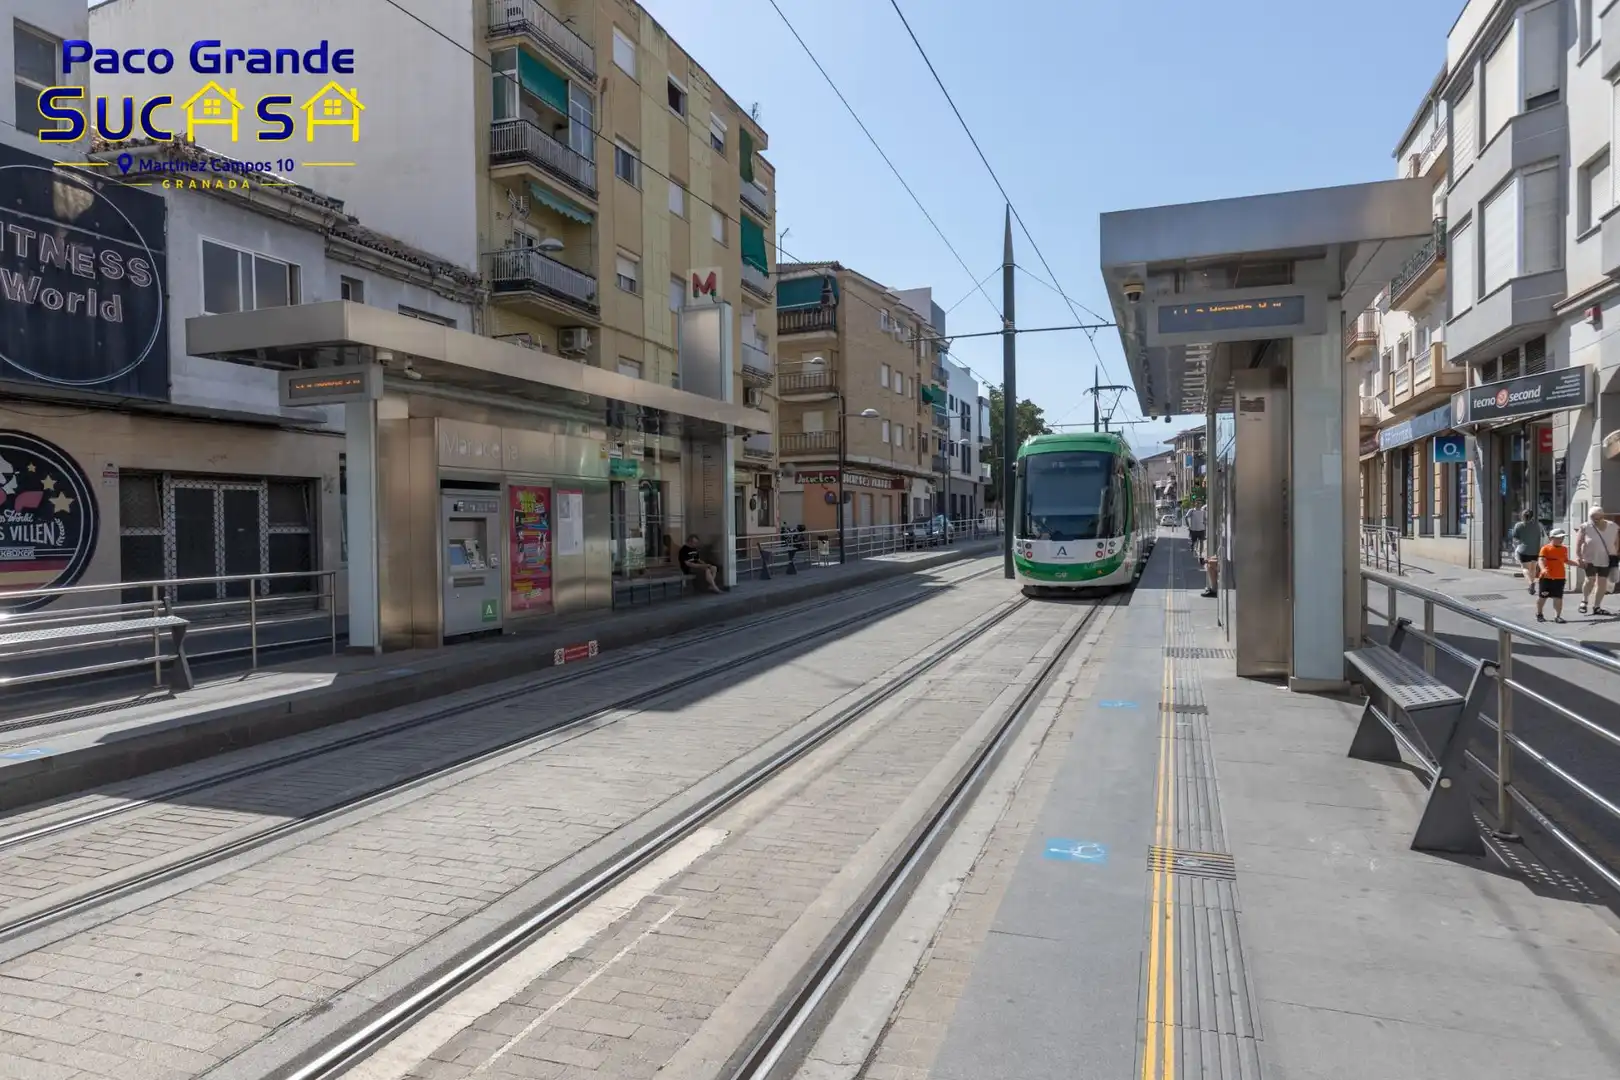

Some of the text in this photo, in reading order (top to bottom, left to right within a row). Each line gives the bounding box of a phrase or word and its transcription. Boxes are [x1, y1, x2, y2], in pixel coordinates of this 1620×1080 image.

[0, 267, 123, 322] World
[692, 271, 717, 298] M
[1473, 396, 1496, 409] tecno
[1509, 384, 1542, 402] second
[10, 521, 55, 545] VILLEN
